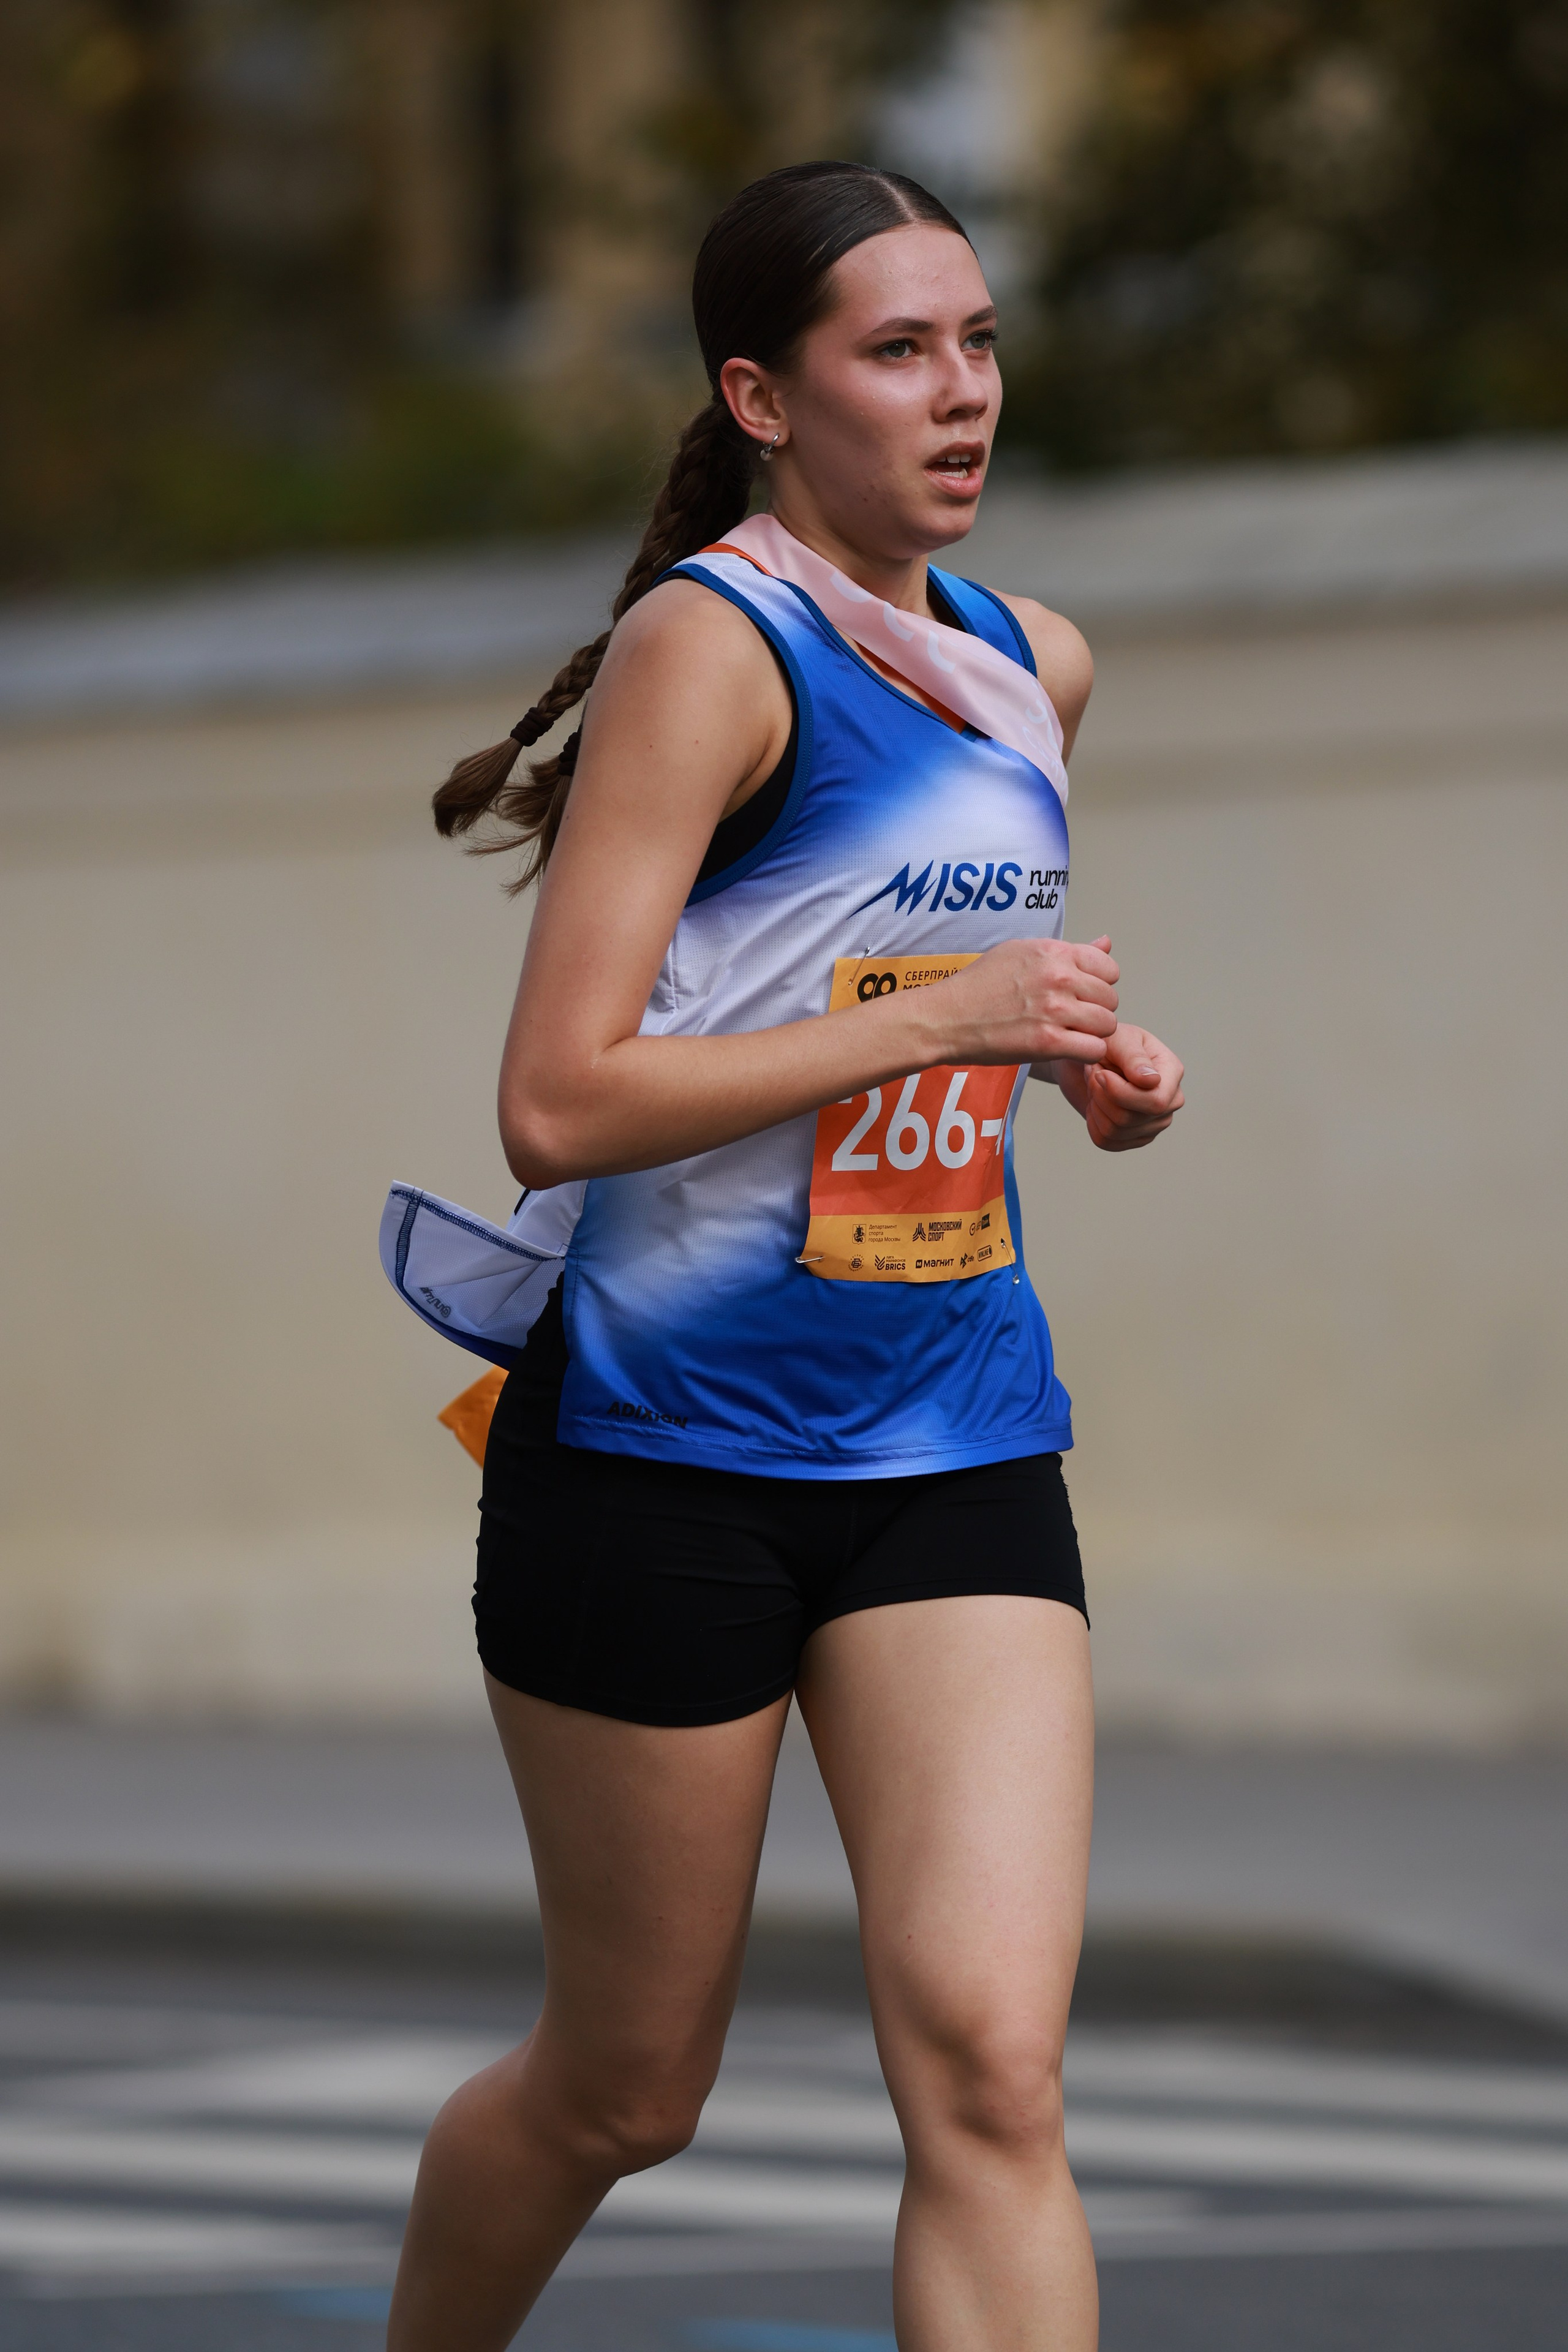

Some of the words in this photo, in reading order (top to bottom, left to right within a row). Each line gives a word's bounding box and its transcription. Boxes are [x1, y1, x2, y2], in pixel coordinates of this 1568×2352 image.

[1030, 865, 1069, 886] runni
[846, 860, 1023, 919] MISIS
[1025, 889, 1058, 909] club
[905, 968, 963, 981] СБЕРПРАЙ
[831, 1072, 1005, 1171] 266-
[929, 1219, 962, 1232] МОСКОВСКИЙ
[928, 1232, 944, 1242] СПОРТ
